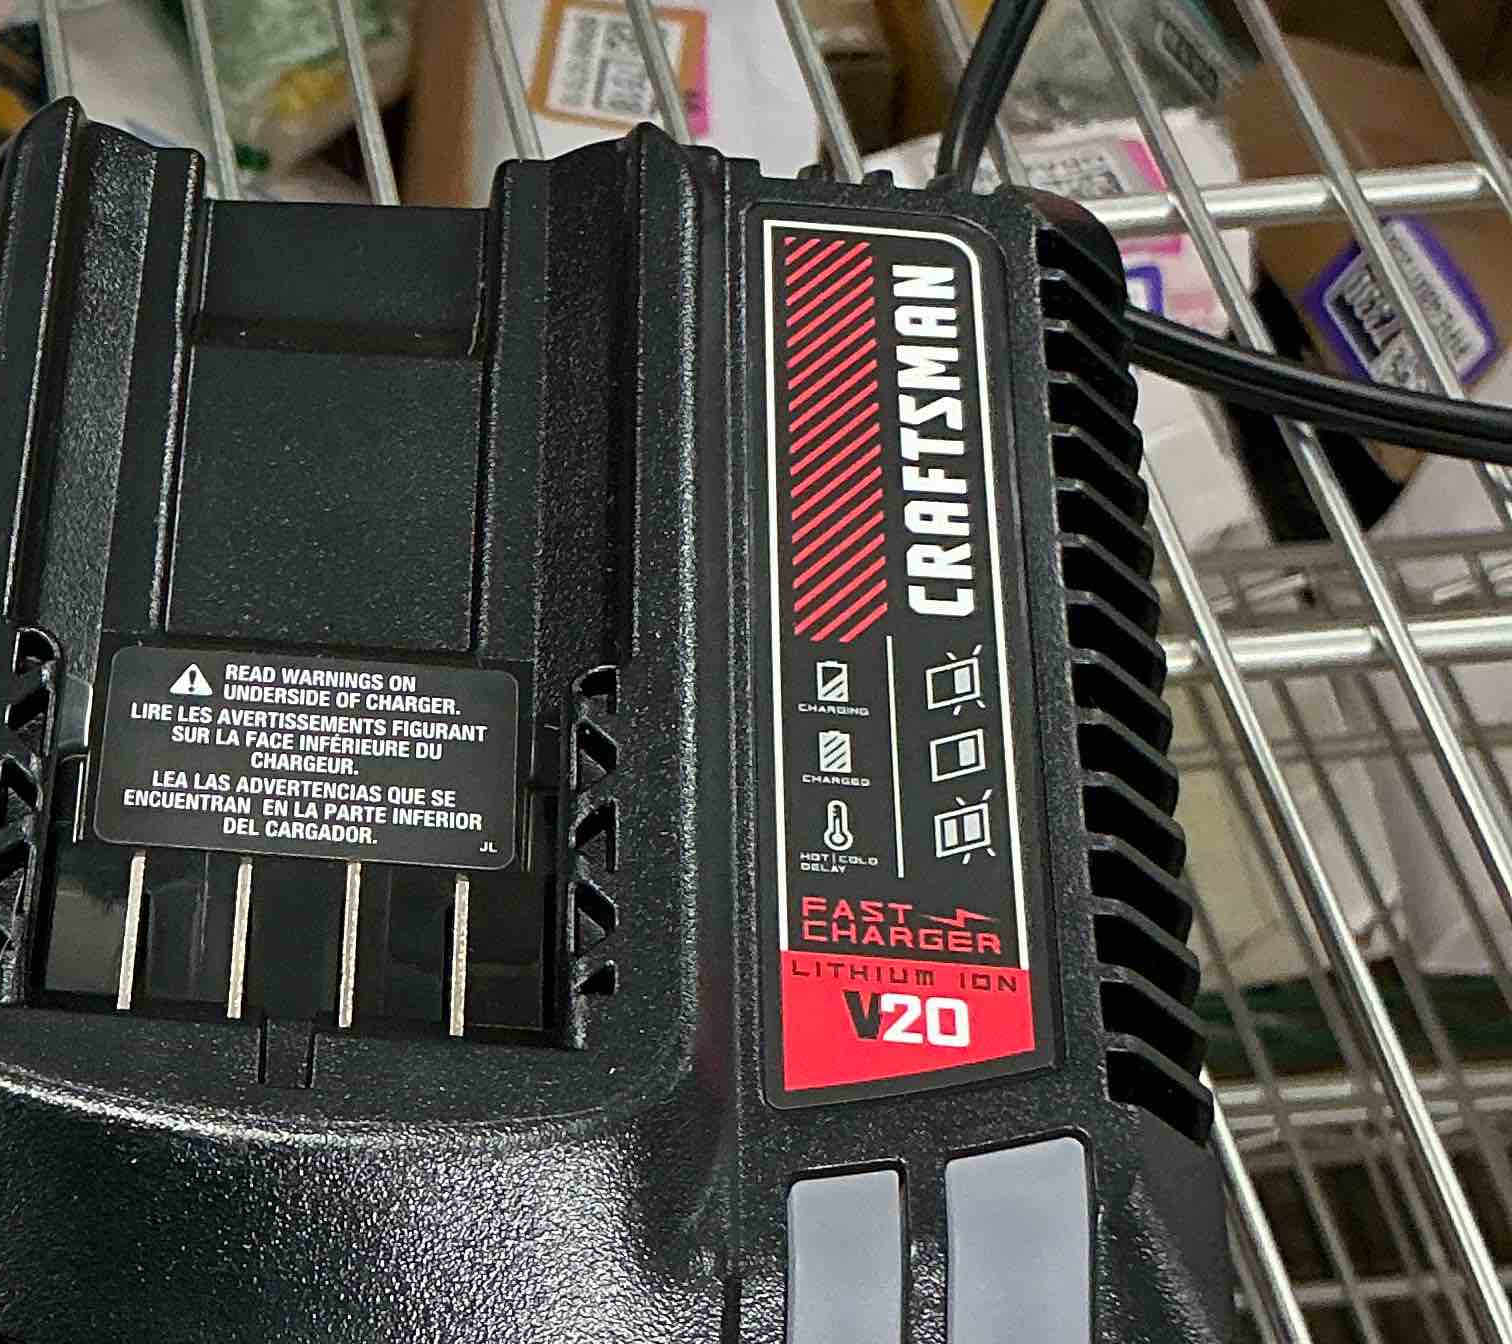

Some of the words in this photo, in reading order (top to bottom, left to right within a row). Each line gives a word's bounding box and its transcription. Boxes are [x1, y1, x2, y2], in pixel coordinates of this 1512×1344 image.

[892, 264, 976, 617] CRAFTSMAN
[225, 664, 276, 683] READ
[282, 667, 384, 691] WARNINGS
[389, 674, 416, 692] ON
[223, 683, 331, 706] UNDERSIDE
[335, 691, 361, 709] OF
[365, 693, 461, 715] CHARGER.
[798, 703, 870, 716] CHARGING
[130, 702, 173, 721] LIRE
[177, 705, 213, 724] LES
[217, 708, 386, 736] AVERTISSEMENTS
[391, 719, 488, 742] FIGURANT
[171, 725, 209, 744] SUR
[215, 729, 240, 746] LA
[245, 730, 294, 750] FACE
[415, 742, 442, 760] DU
[250, 751, 359, 775] CHARGEUR.
[152, 769, 188, 789] LEA
[193, 772, 231, 791] LAS
[235, 776, 382, 803] ADVERTENCIAS
[387, 786, 426, 806] QUE
[431, 789, 456, 808] SE
[802, 774, 870, 787] CHARGED
[123, 788, 251, 814] ENCUENTRAN
[262, 798, 288, 817] EN
[293, 801, 319, 820] LA
[324, 803, 387, 824] PARTE
[392, 807, 482, 831] INFERIOR
[223, 816, 260, 836] DEL
[265, 820, 378, 845] CARGADOR.
[479, 841, 498, 853] JL
[800, 862, 847, 873] DELAY
[801, 896, 913, 925] FAST
[802, 920, 1001, 954] CHARGER
[792, 959, 936, 987] LITHIUM
[959, 971, 1017, 993] ION
[842, 989, 971, 1048] V20
